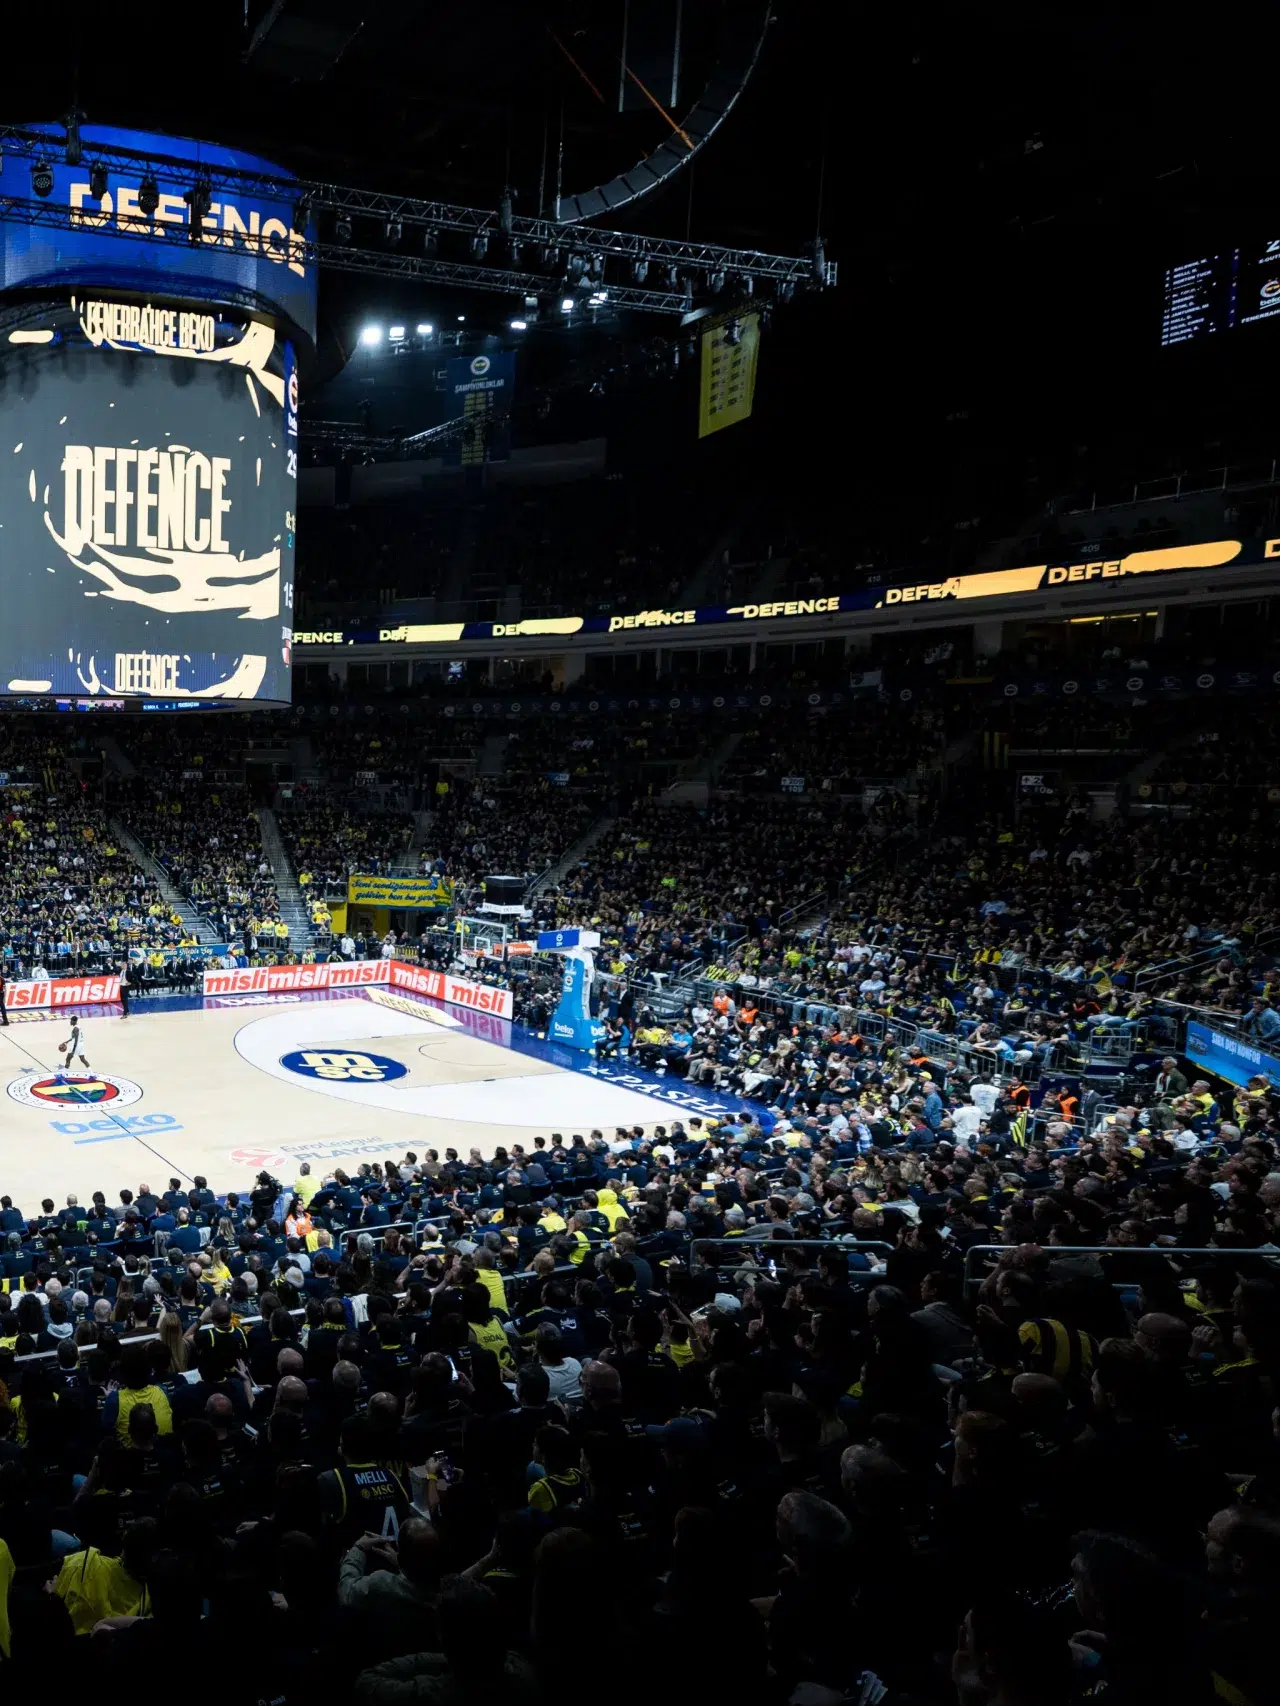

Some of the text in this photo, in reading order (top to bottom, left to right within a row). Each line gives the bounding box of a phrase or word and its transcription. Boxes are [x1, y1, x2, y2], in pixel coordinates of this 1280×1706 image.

[69, 183, 306, 278] DEFENCE
[179, 311, 215, 352] BEKO
[64, 445, 232, 553] DEFENCE
[1047, 559, 1122, 585] DEFE
[743, 596, 840, 619] DEFENCE
[114, 652, 181, 693] DEFENCE
[204, 969, 269, 993] misli
[269, 965, 330, 989] misli
[331, 962, 390, 985] misli
[394, 967, 440, 995] misli
[52, 978, 121, 1005] misli
[451, 983, 505, 1014] misli
[554, 1022, 575, 1034] beko
[48, 1113, 177, 1135] beko
[279, 1136, 383, 1154] EuroLeague
[353, 1469, 388, 1485] MELLI
[370, 1484, 395, 1496] MSC
